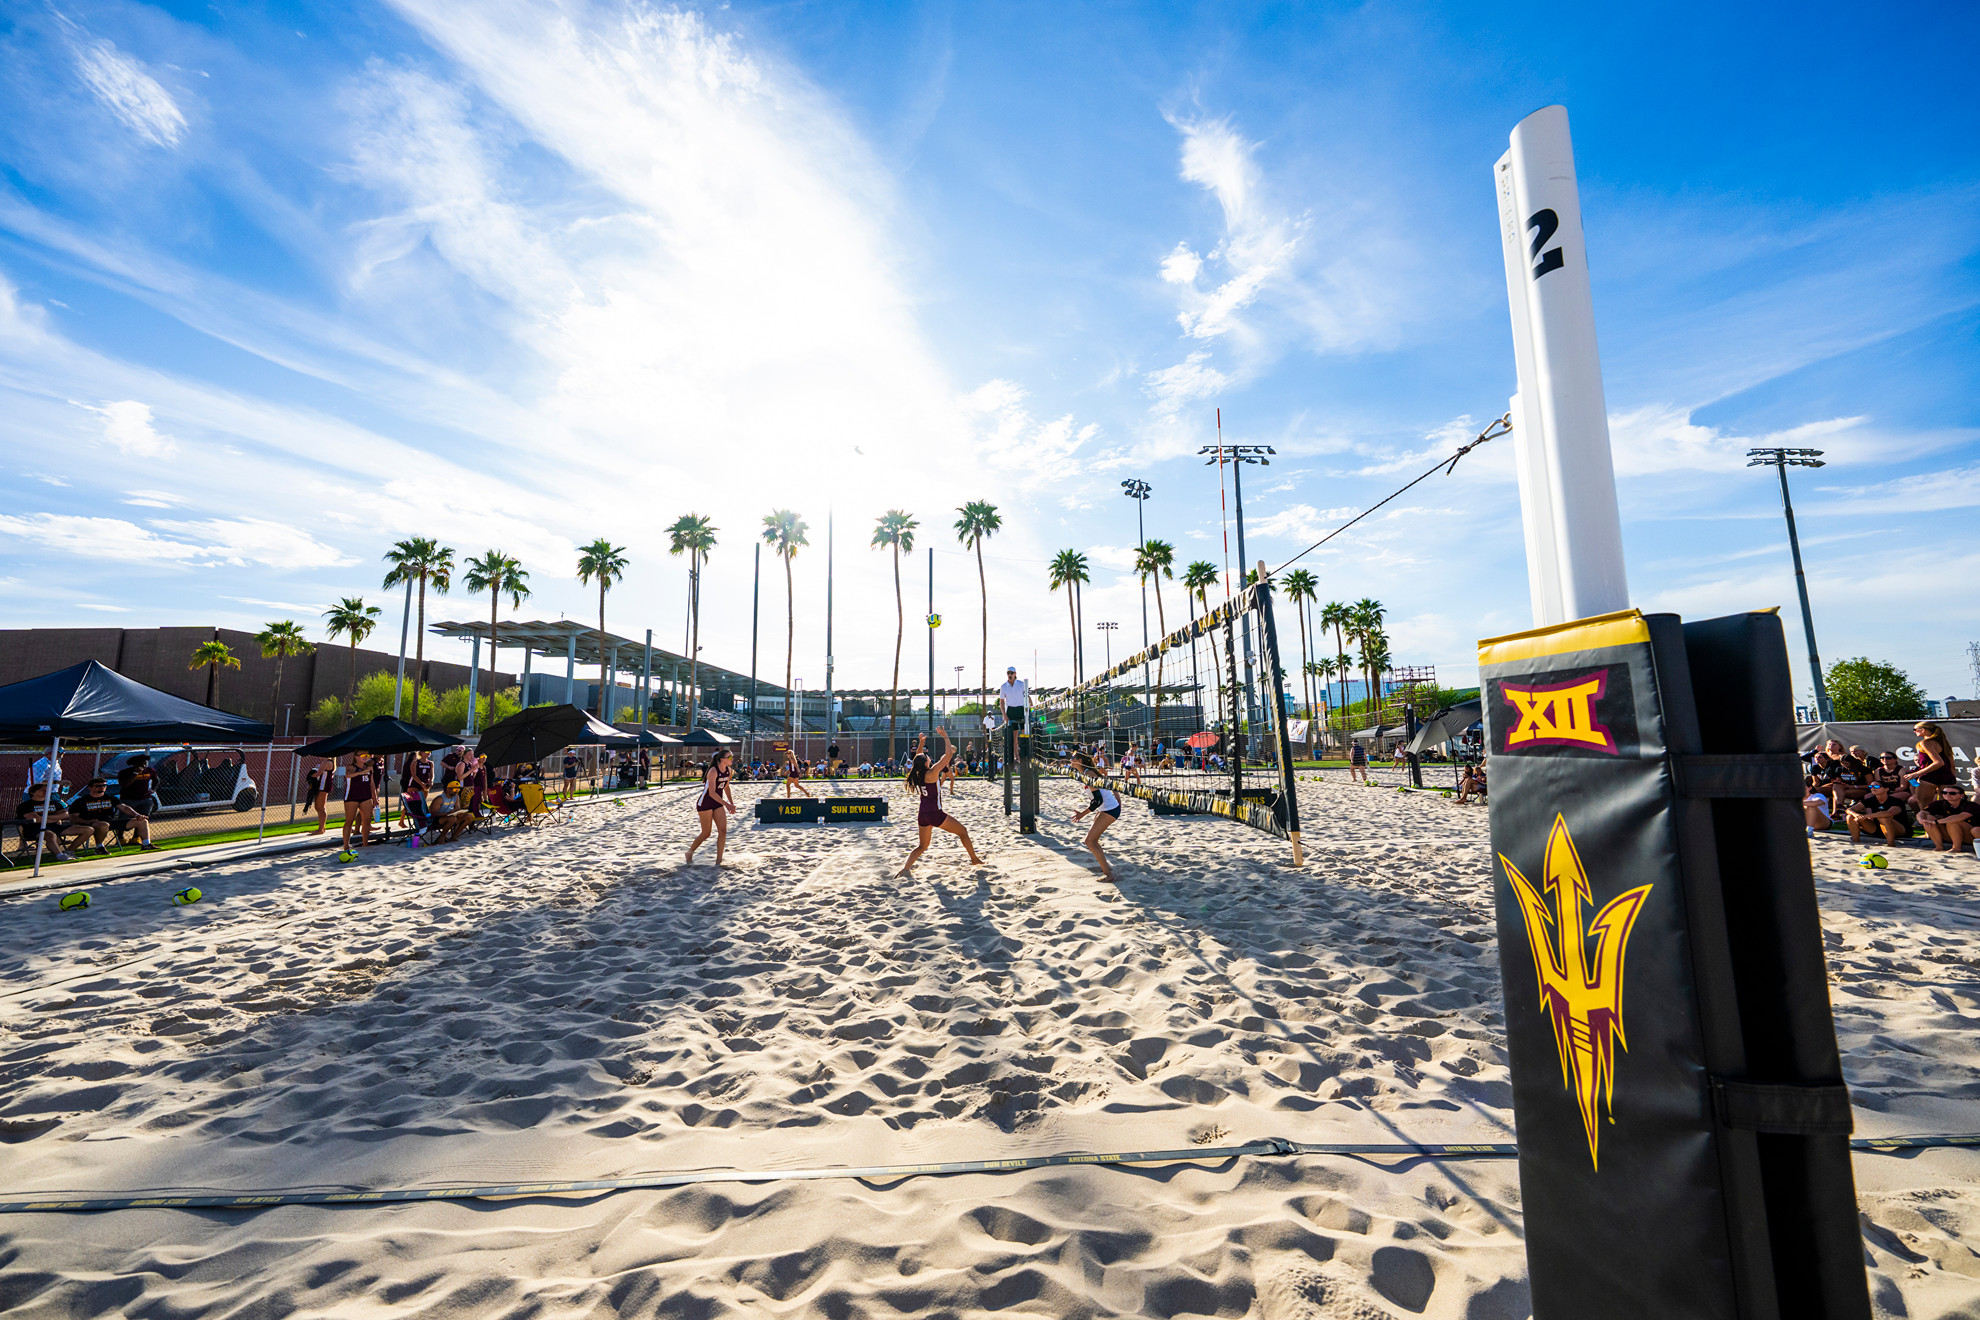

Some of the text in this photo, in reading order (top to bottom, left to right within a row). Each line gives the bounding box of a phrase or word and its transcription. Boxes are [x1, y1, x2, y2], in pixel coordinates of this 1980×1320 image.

[1525, 208, 1564, 281] 2
[1500, 674, 1612, 750] XII
[785, 805, 801, 815] ASU
[831, 805, 876, 814] SUN DEVILS
[1068, 1155, 1099, 1163] ARIZONA
